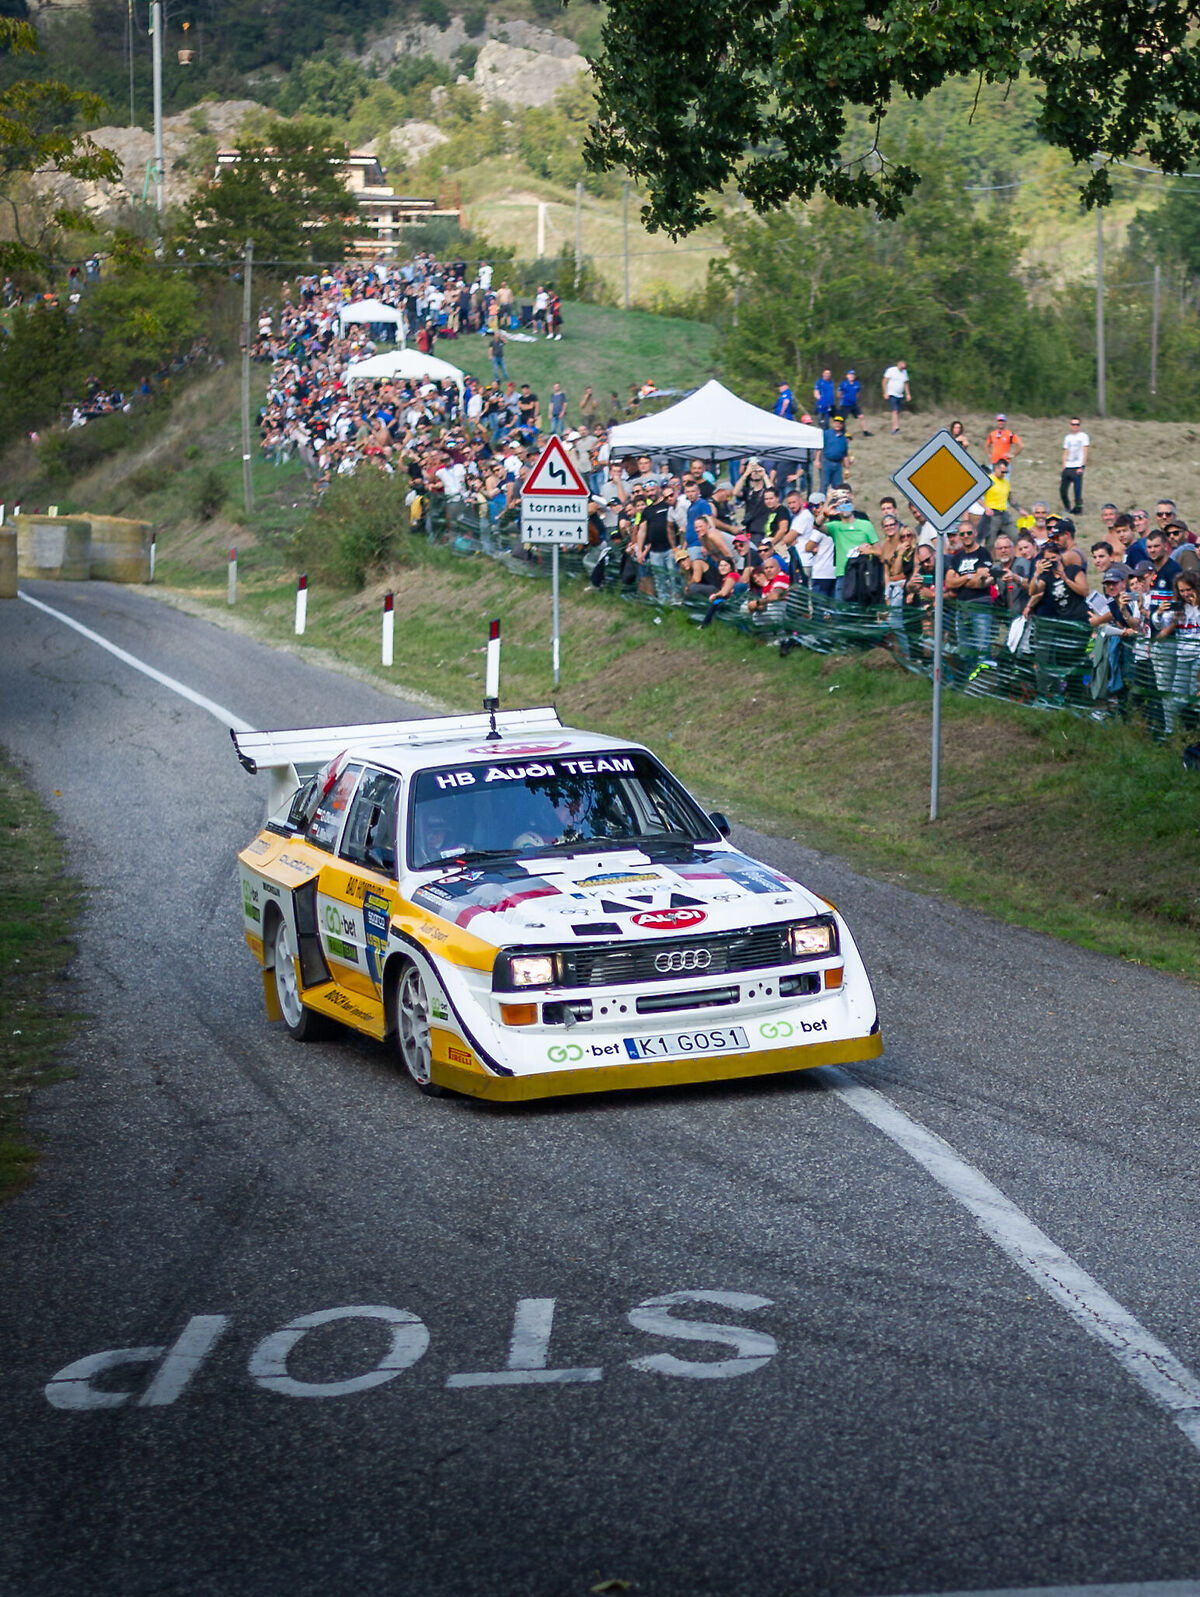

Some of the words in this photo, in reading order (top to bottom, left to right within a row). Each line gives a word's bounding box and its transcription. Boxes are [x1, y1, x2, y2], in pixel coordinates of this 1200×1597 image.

[529, 503, 581, 513] tornanti
[437, 772, 476, 789] HB
[560, 758, 635, 775] TEAM
[639, 1037, 669, 1056] K1
[677, 1029, 742, 1051] GOS1
[44, 1289, 779, 1411] STOP
